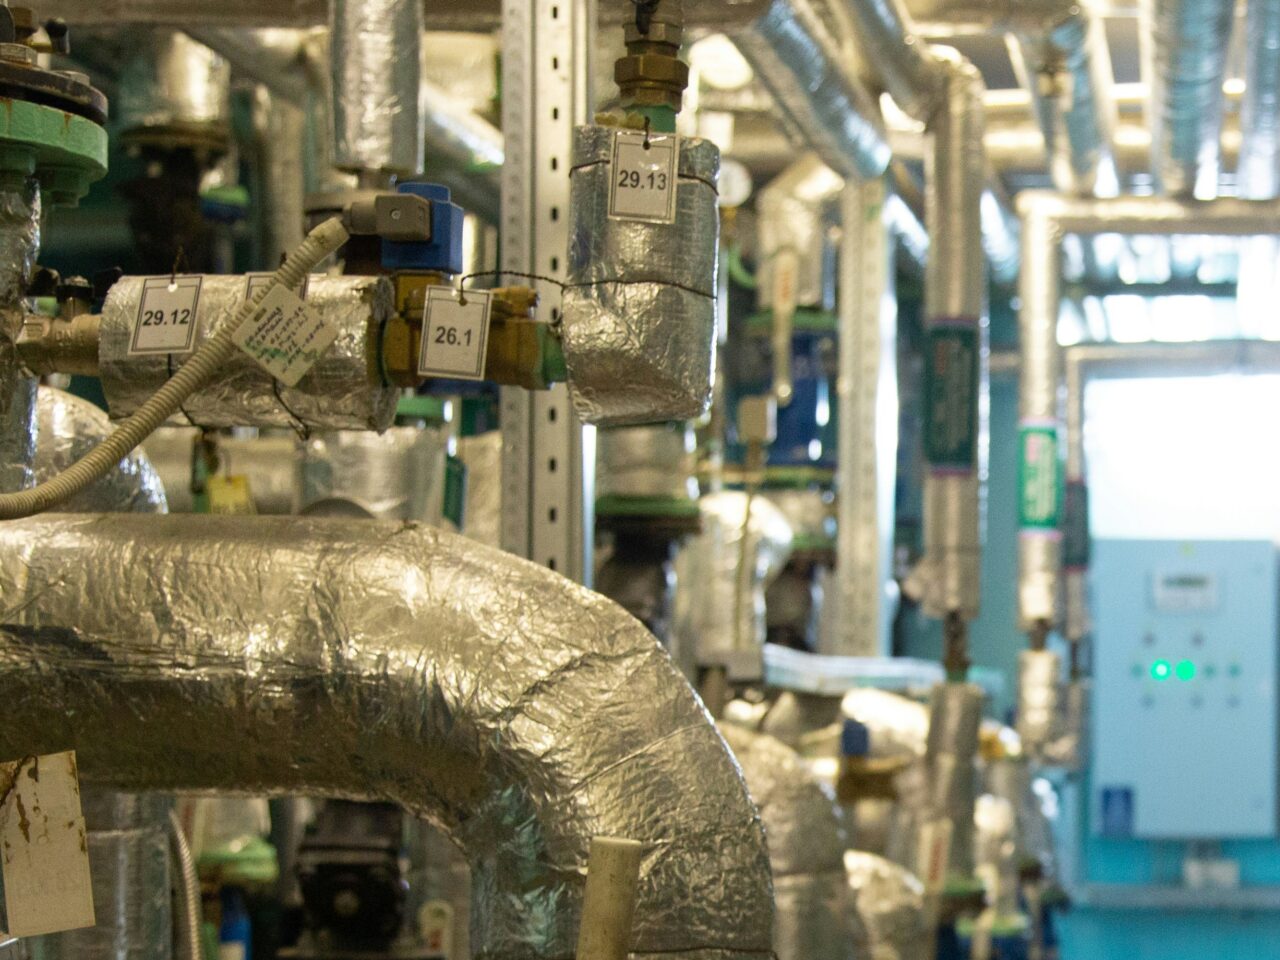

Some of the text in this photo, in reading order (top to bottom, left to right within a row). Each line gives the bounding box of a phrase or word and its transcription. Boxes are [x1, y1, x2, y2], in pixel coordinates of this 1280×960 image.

[618, 169, 667, 190] 29.13
[142, 308, 190, 326] 29.12
[434, 326, 472, 347] 26.1
